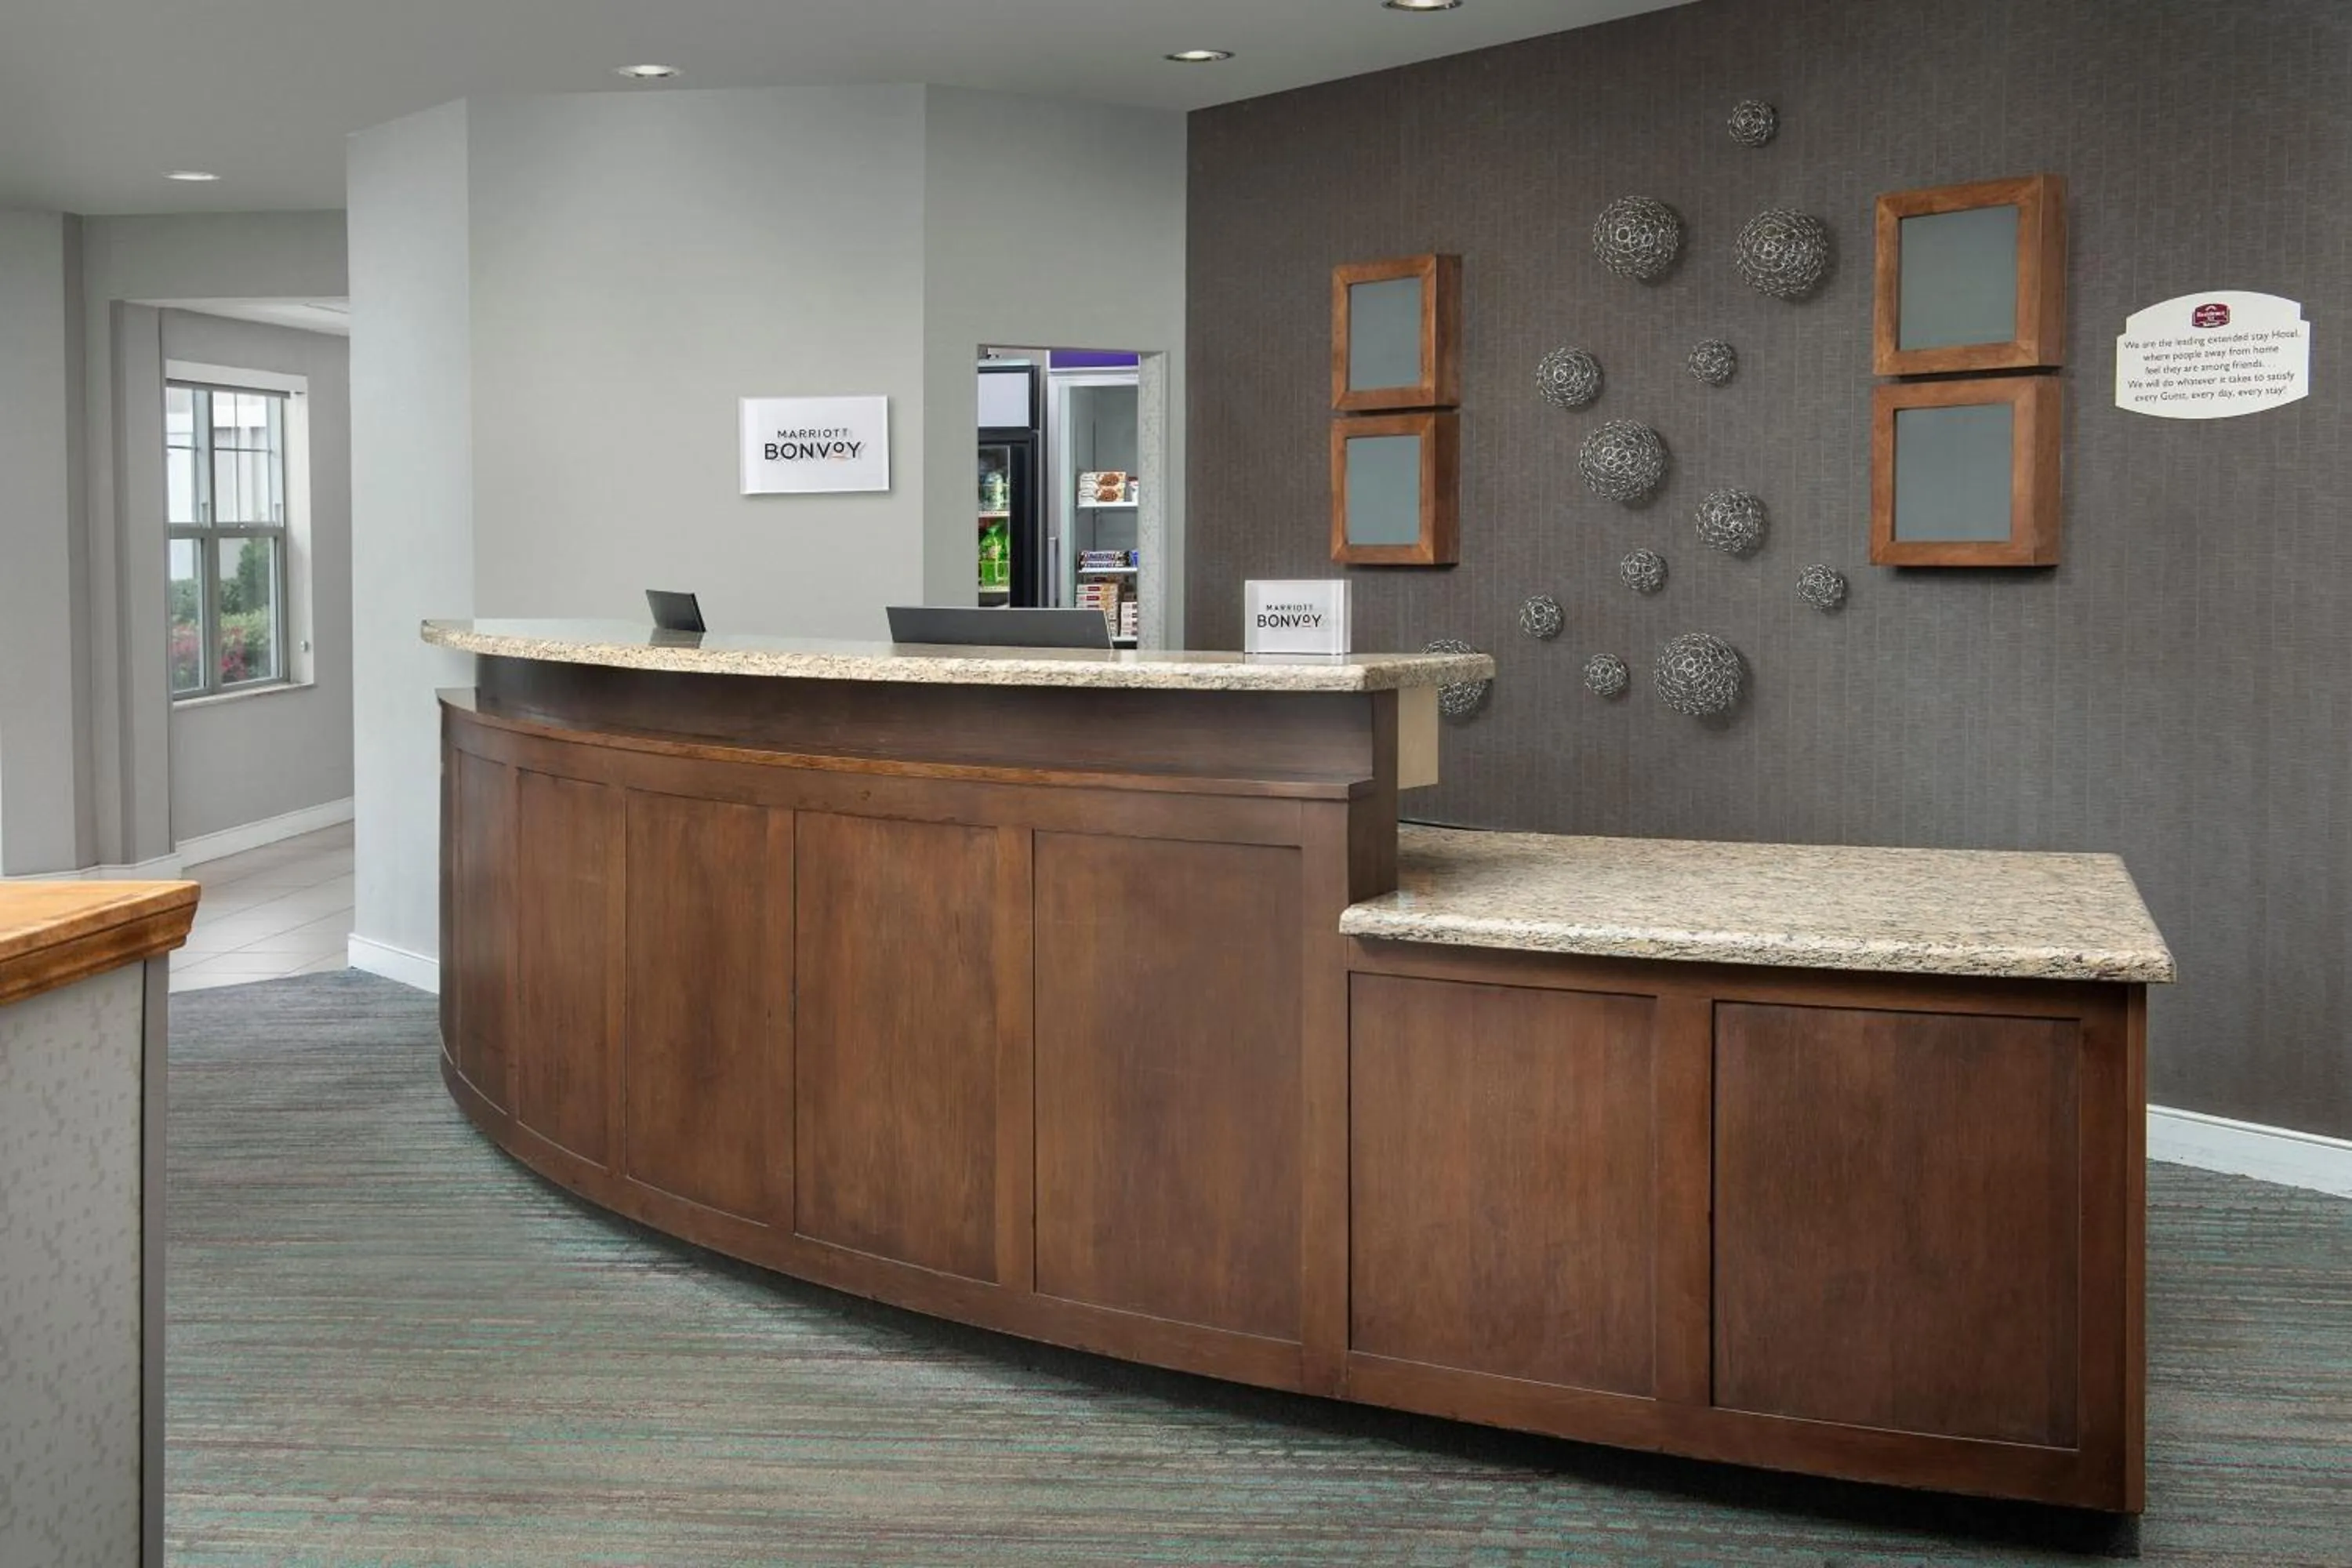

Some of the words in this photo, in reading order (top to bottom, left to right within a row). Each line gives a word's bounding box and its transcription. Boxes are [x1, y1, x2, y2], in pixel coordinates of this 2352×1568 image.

[2176, 336, 2205, 347] leading
[2208, 333, 2249, 343] extended
[2251, 333, 2269, 343] stay
[2172, 350, 2201, 361] people
[2205, 350, 2226, 358] away
[2229, 347, 2250, 355] from
[2145, 365, 2161, 374] feel
[2164, 365, 2180, 375] they
[2201, 363, 2230, 372] among
[2128, 379, 2143, 388] We
[2177, 377, 2216, 386] whatever
[2229, 373, 2251, 383] takes
[2267, 371, 2295, 382] satisfy
[2191, 391, 2214, 401] every
[2238, 389, 2263, 398] every
[777, 427, 848, 439] MARRIOTT
[764, 441, 862, 459] BONVOY
[1257, 614, 1323, 628] BONVOY
